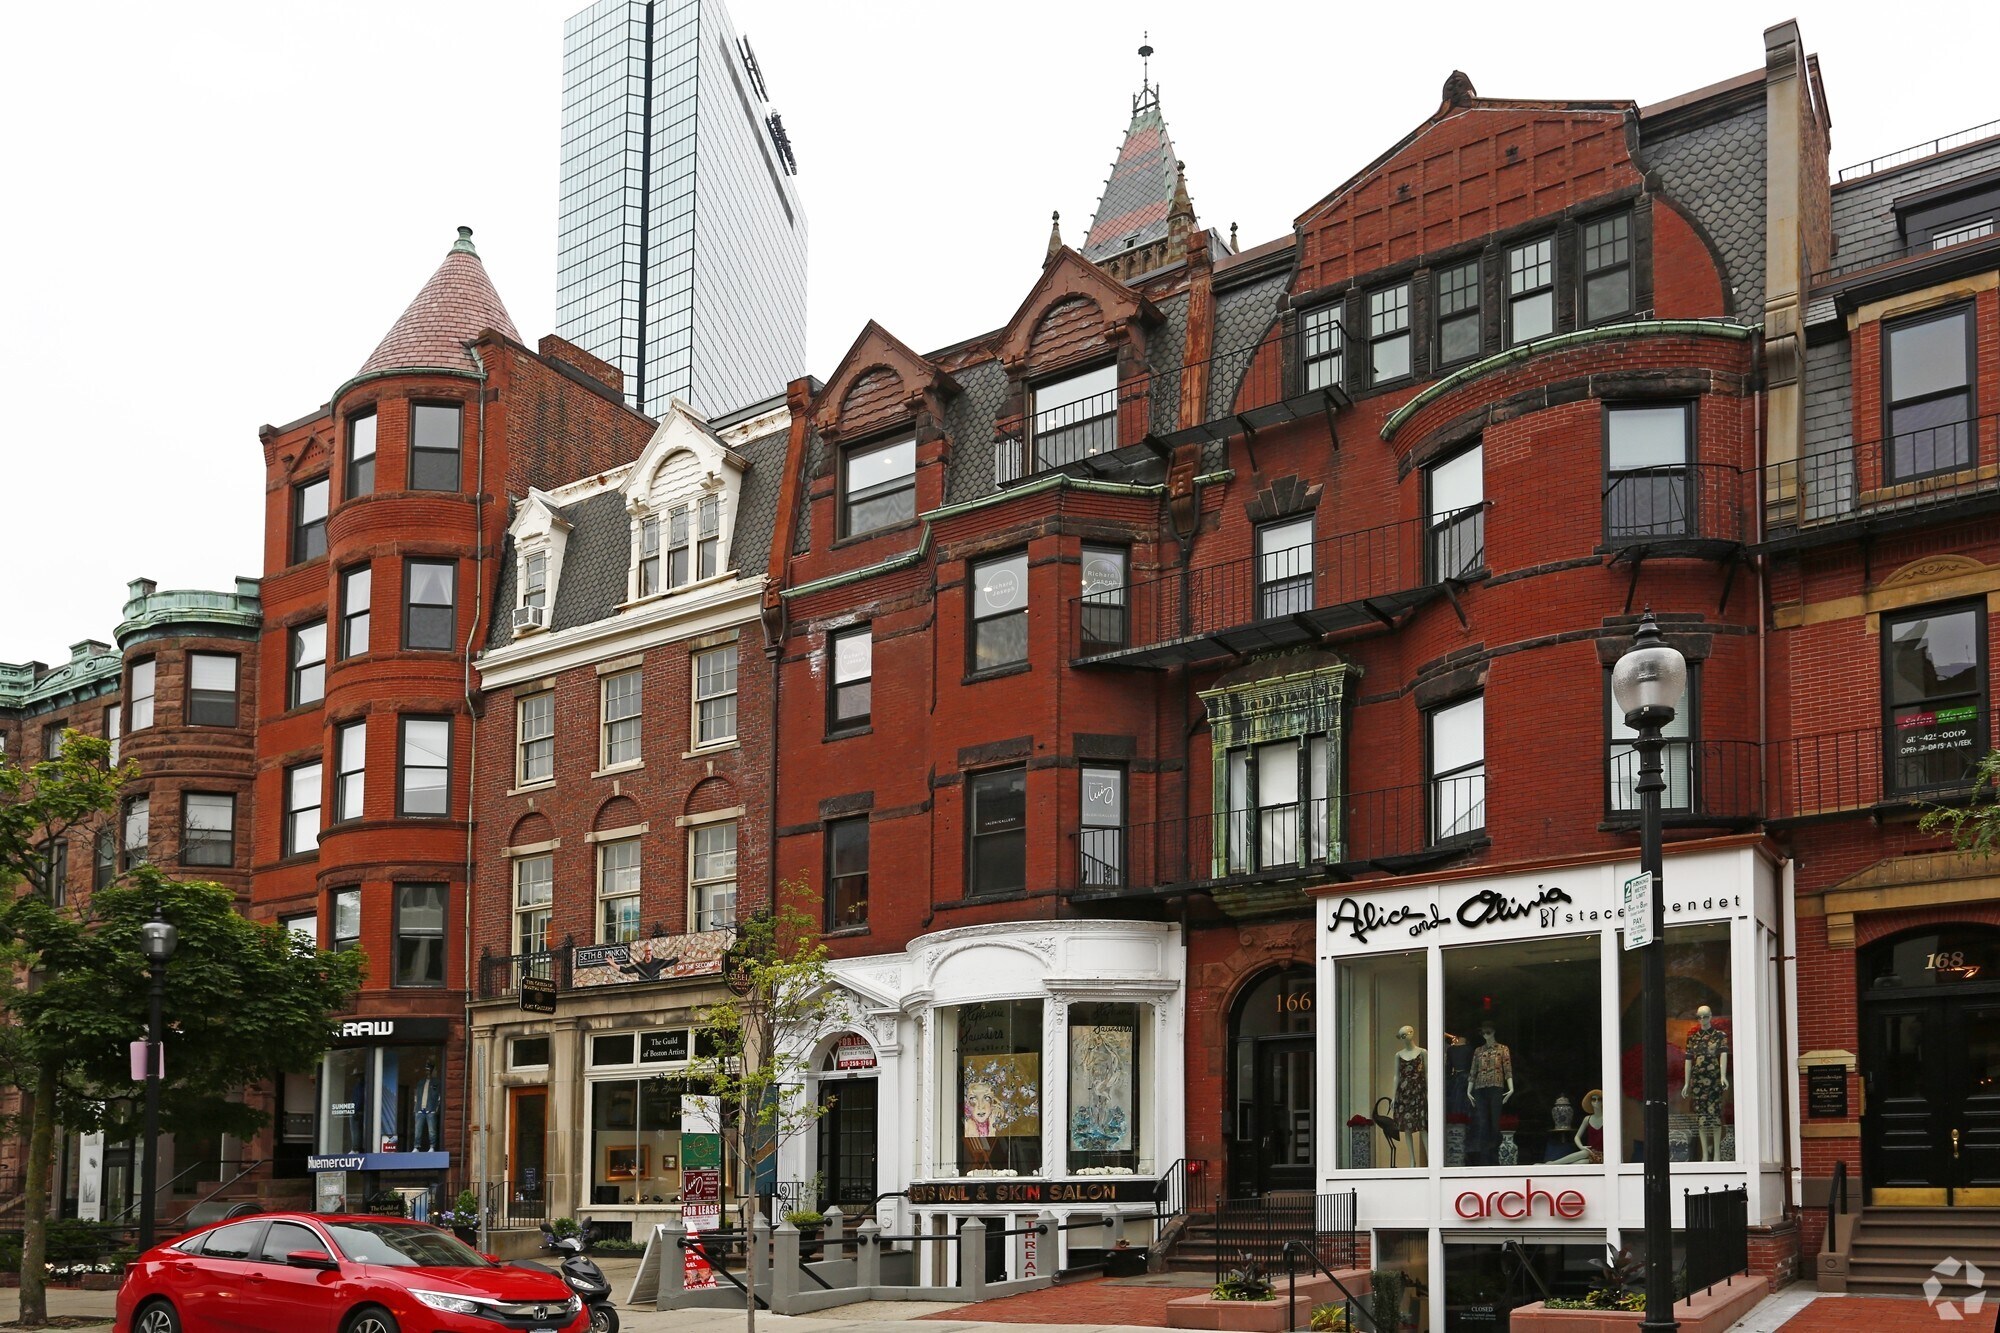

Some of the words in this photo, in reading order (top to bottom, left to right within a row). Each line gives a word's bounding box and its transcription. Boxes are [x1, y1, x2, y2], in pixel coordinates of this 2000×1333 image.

[1625, 882, 1631, 897] 2
[1328, 898, 1426, 944] Alice
[1409, 903, 1451, 937] and
[1457, 884, 1572, 928] Olivia
[1540, 906, 1558, 928] BY
[1565, 908, 1625, 923] stace
[1663, 894, 1741, 913] endet
[1633, 916, 1643, 925] PAY
[580, 952, 596, 960] SETH
[1924, 951, 1965, 970] 168
[695, 961, 714, 969] SECOND
[1276, 992, 1312, 1013] 166
[342, 1021, 394, 1037] RAW
[651, 1038, 662, 1046] The
[663, 1037, 678, 1045] Guild
[643, 1050, 649, 1058] of
[650, 1049, 667, 1057] Boston
[668, 1048, 686, 1056] Artists
[308, 1155, 365, 1171] bluemercury
[939, 1185, 970, 1201] NAIL
[996, 1184, 1041, 1201] SKIN
[1049, 1184, 1117, 1201] SALON
[1455, 1179, 1586, 1219] arche
[683, 1206, 697, 1216] FOR
[698, 1204, 719, 1215] LEASE
